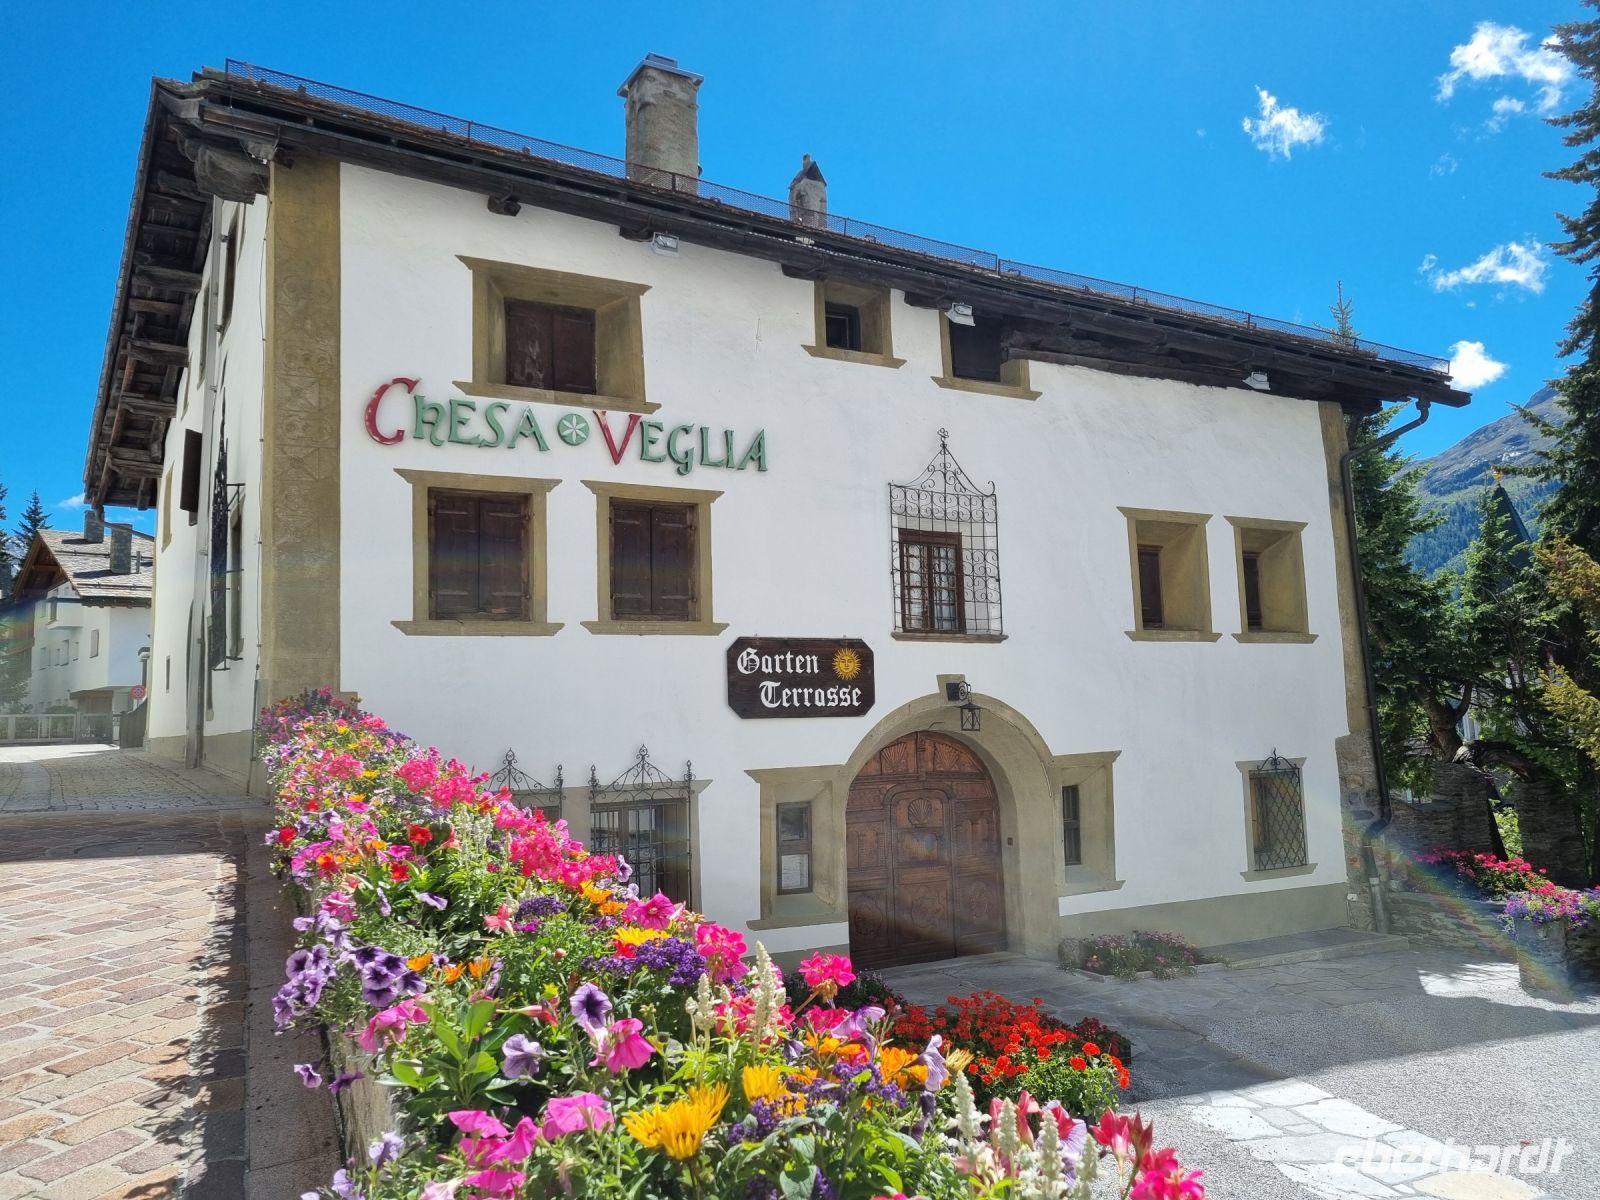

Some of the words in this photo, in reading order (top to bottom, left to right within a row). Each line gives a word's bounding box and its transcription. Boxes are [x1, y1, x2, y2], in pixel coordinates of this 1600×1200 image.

[593, 410, 768, 476] VEGLIA
[737, 647, 819, 674] Garten
[758, 680, 862, 708] Terrasse
